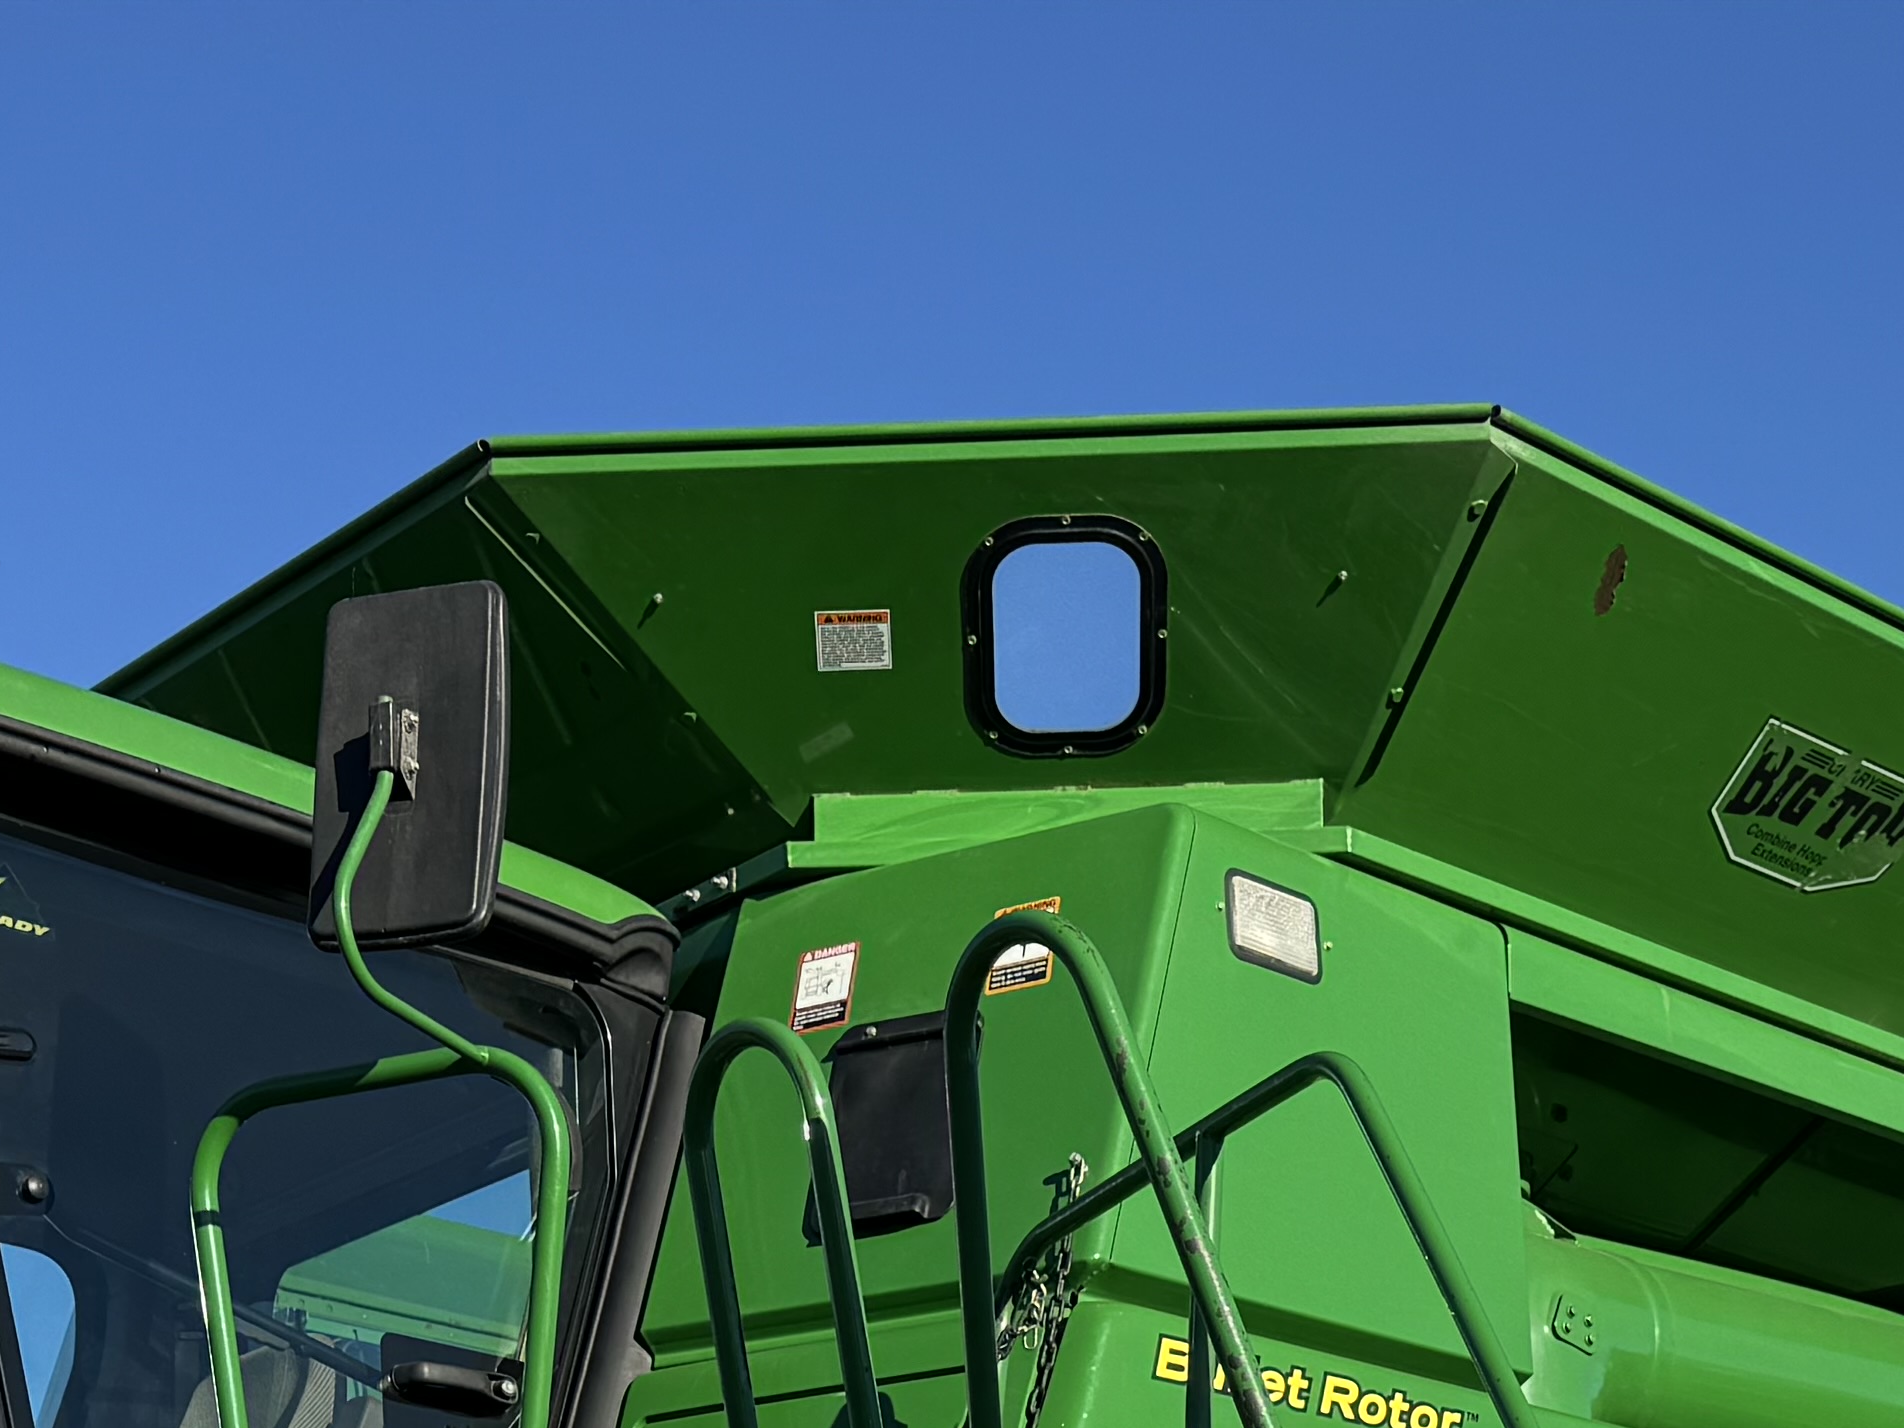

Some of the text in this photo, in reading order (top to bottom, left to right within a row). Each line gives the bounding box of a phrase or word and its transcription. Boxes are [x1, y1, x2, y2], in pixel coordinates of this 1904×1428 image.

[1723, 738, 1834, 828] BIG
[1746, 823, 1797, 853] Combine
[1751, 842, 1813, 877] Extensions
[814, 942, 856, 959] DANGER
